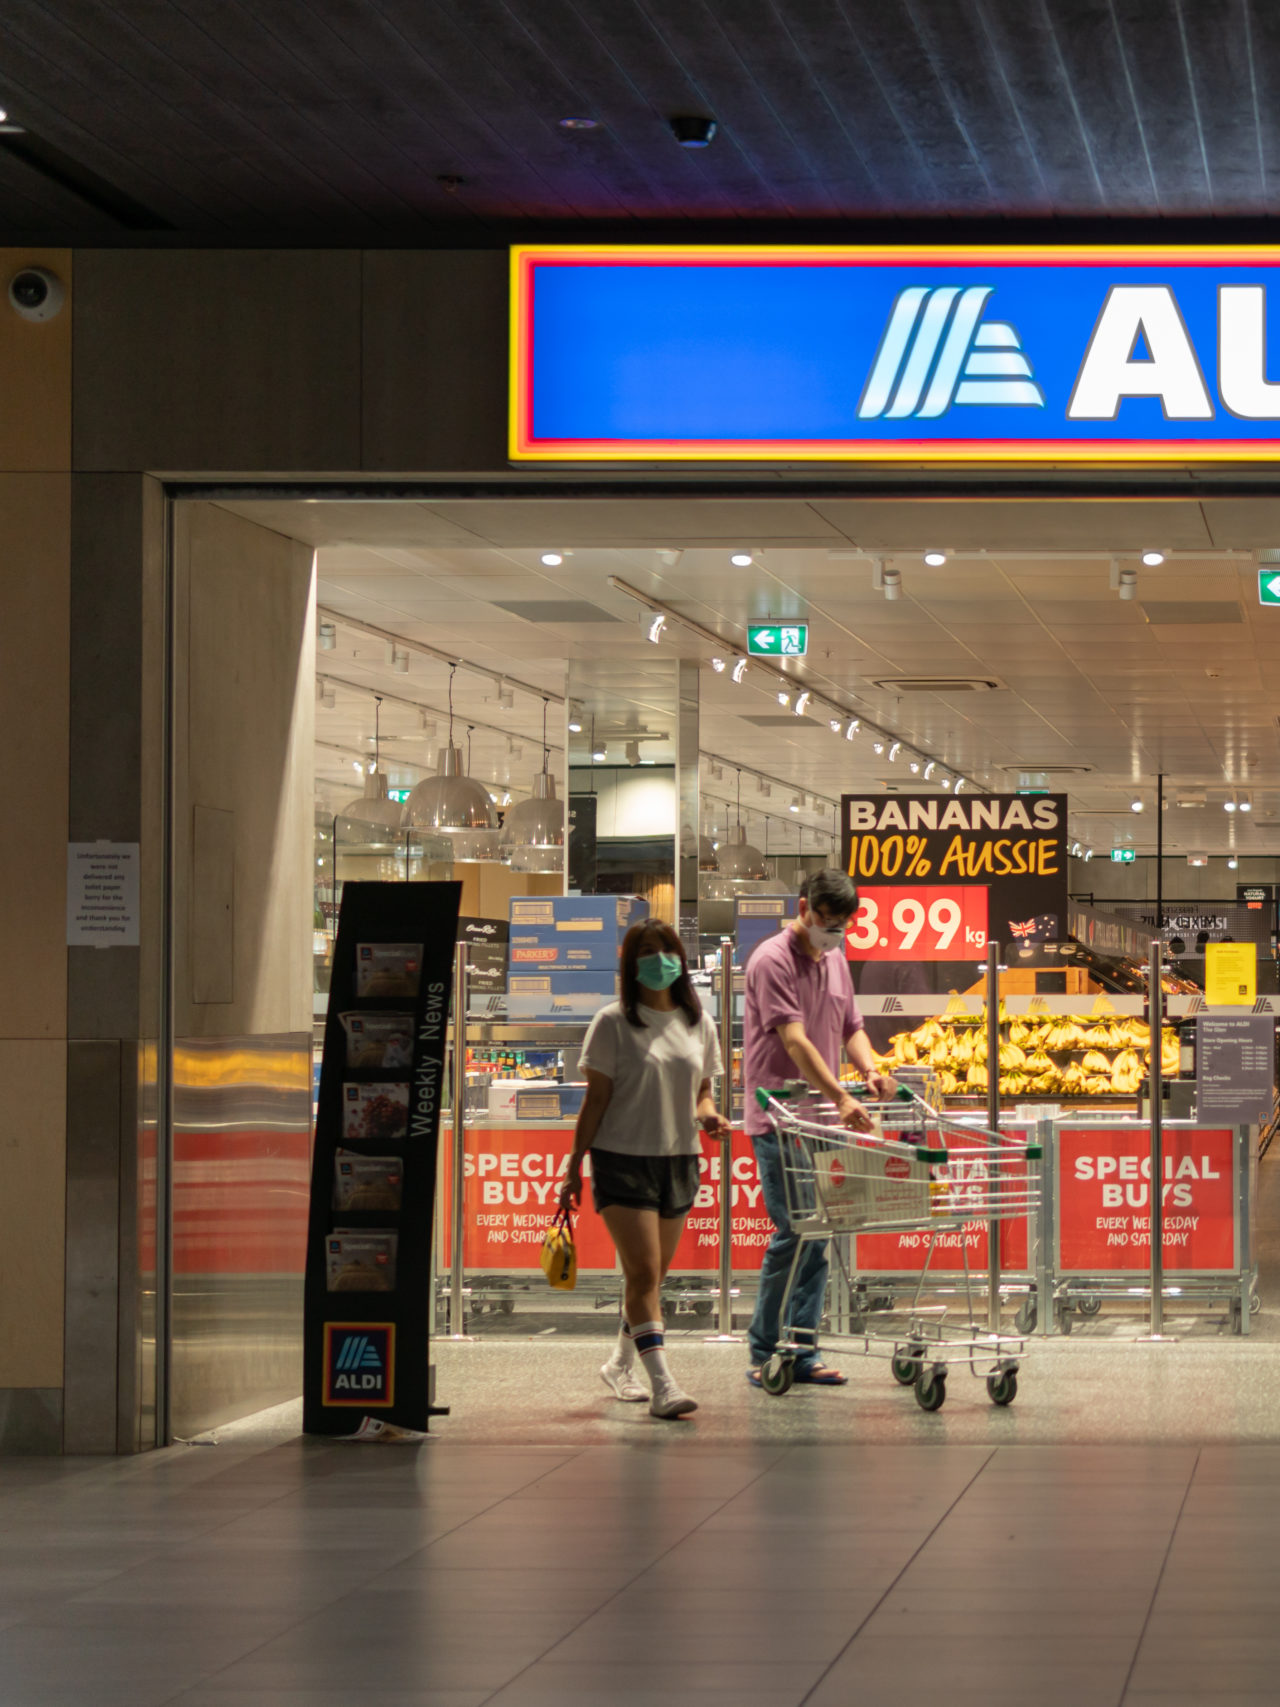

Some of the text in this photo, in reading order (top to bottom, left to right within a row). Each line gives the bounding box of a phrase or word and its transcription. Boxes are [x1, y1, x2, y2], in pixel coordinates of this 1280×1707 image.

[850, 800, 1059, 830] BANANAS
[848, 835, 1059, 877] 100% AUSSIE
[847, 898, 986, 950] 3.99 kg
[419, 982, 444, 1040] News
[410, 1056, 442, 1137] Weekly
[694, 1184, 762, 1208] BUY
[476, 1214, 510, 1227] EVERY
[686, 1217, 720, 1230] EVERY
[1096, 1215, 1200, 1231] EVERY WEESDAY
[487, 1230, 547, 1243] AND SATUR
[697, 1233, 772, 1247] AND ATURDA
[898, 1234, 920, 1248] AND
[1107, 1233, 1128, 1246] AND
[335, 1374, 382, 1389] ALDI
